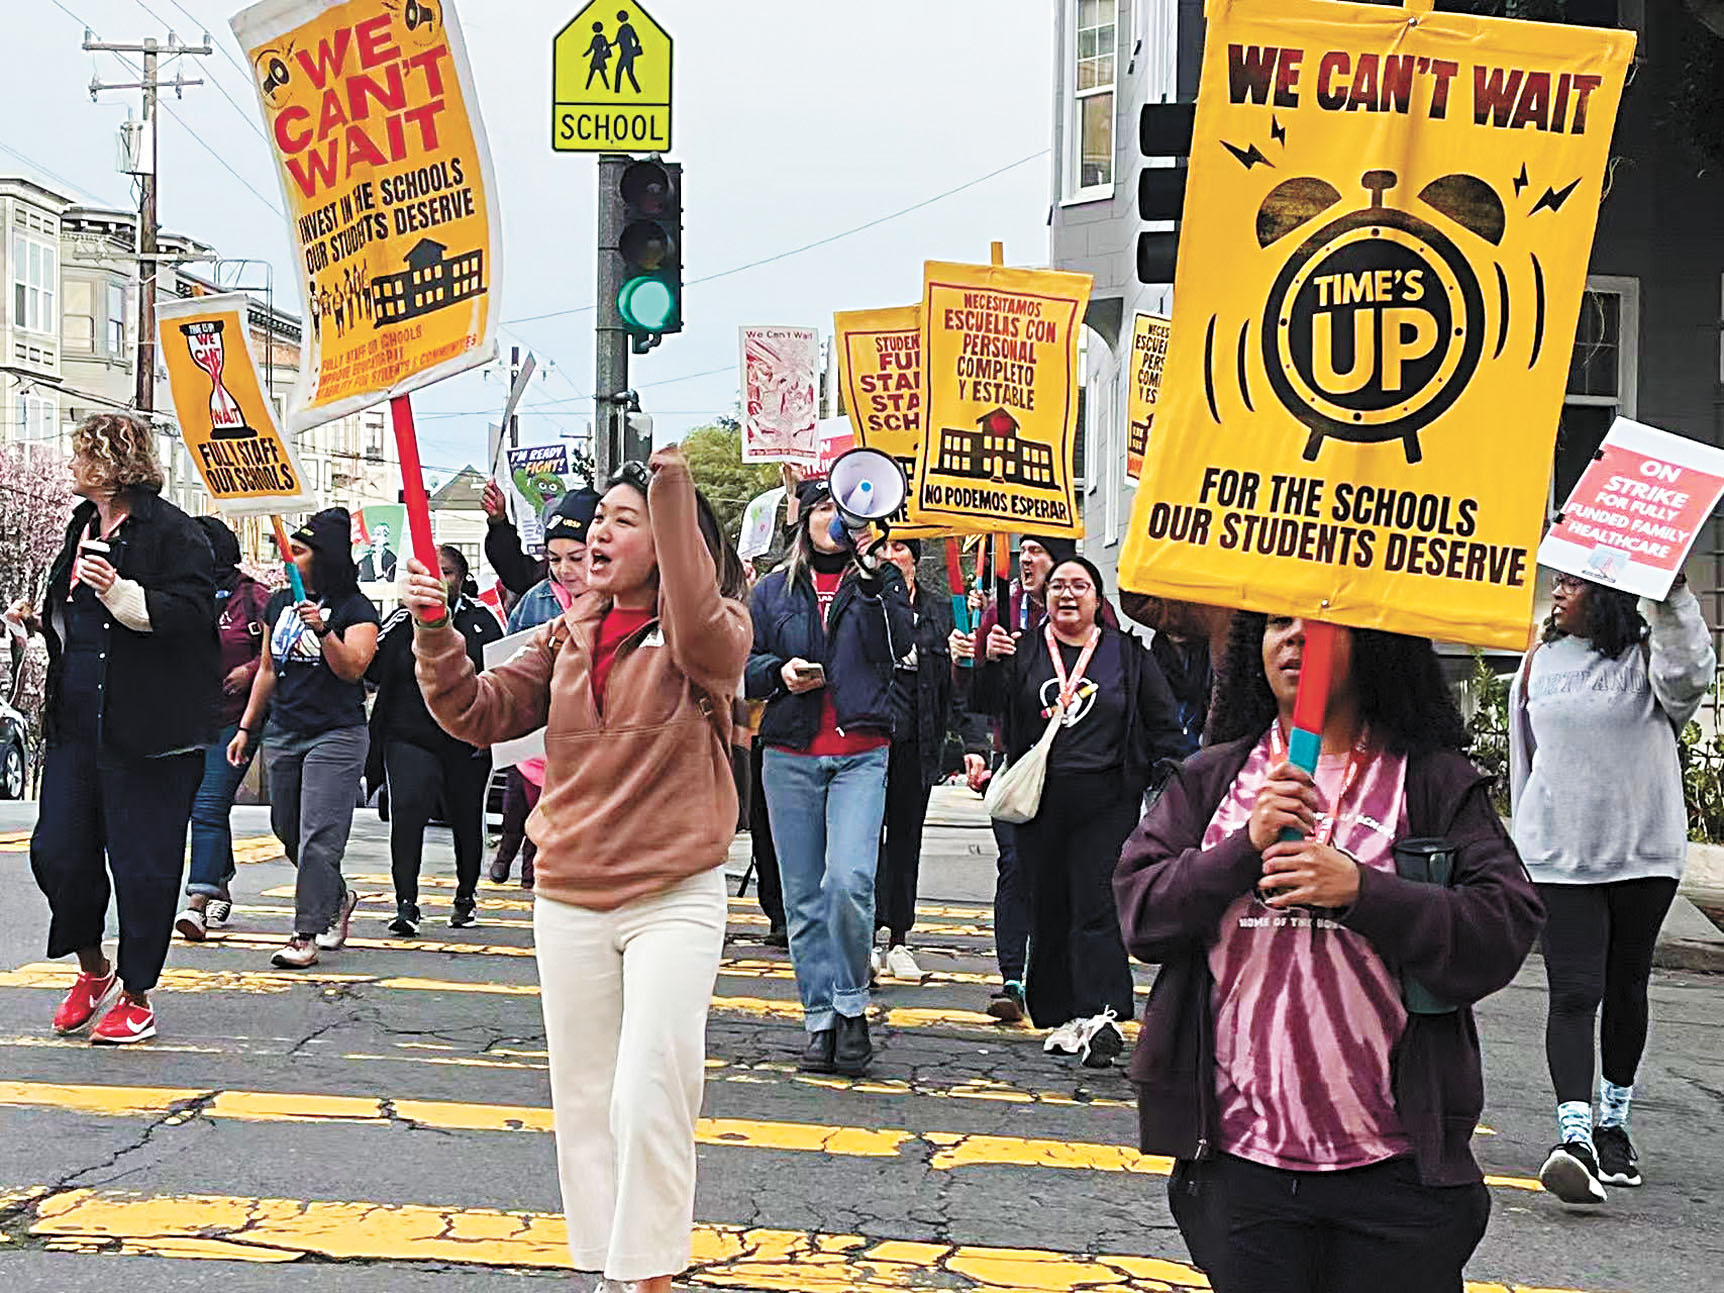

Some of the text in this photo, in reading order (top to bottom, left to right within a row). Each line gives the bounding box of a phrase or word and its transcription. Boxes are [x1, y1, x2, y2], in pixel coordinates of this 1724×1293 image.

[296, 13, 401, 89] WE
[274, 44, 447, 154] CAN'T
[1228, 43, 1603, 134] WE CAN'T WAIT
[560, 114, 664, 141] SCHOOL
[285, 99, 445, 198] WAIT
[298, 202, 339, 245] INVEST
[353, 182, 376, 215] HE
[380, 157, 464, 206] SCHOOLS
[305, 241, 329, 275] OUR
[394, 188, 475, 236] DESERVE
[1313, 269, 1425, 307] TIME'S
[964, 293, 1043, 318] NECESITAMOS
[746, 331, 763, 339] We
[944, 309, 1057, 343] ESCUELAS CON
[875, 333, 920, 353] STUDEN
[962, 333, 1037, 364] PERSONAL
[1312, 307, 1438, 395] UP
[957, 355, 1034, 387] COMPLETO
[958, 379, 1035, 411] Y ESTABLE
[212, 408, 240, 425] WAIT
[197, 438, 279, 468] FULLY STAFF
[510, 446, 564, 463] I'M READY
[525, 458, 566, 474] FIGHT!
[206, 463, 295, 494] OUR SCHOOLS
[1640, 460, 1682, 483] ON
[925, 484, 1067, 521] NO PODEMOS ESPERAR
[1200, 467, 1478, 538] FOR THE SCHOOLS
[1595, 492, 1680, 522] FOR FULLY
[1603, 476, 1689, 508] STRIKE
[1566, 503, 1690, 543] FUNDED FAMILY
[1148, 502, 1528, 588] OUR STUDENTS DESERVE
[1568, 521, 1671, 559] HEALTHCARE
